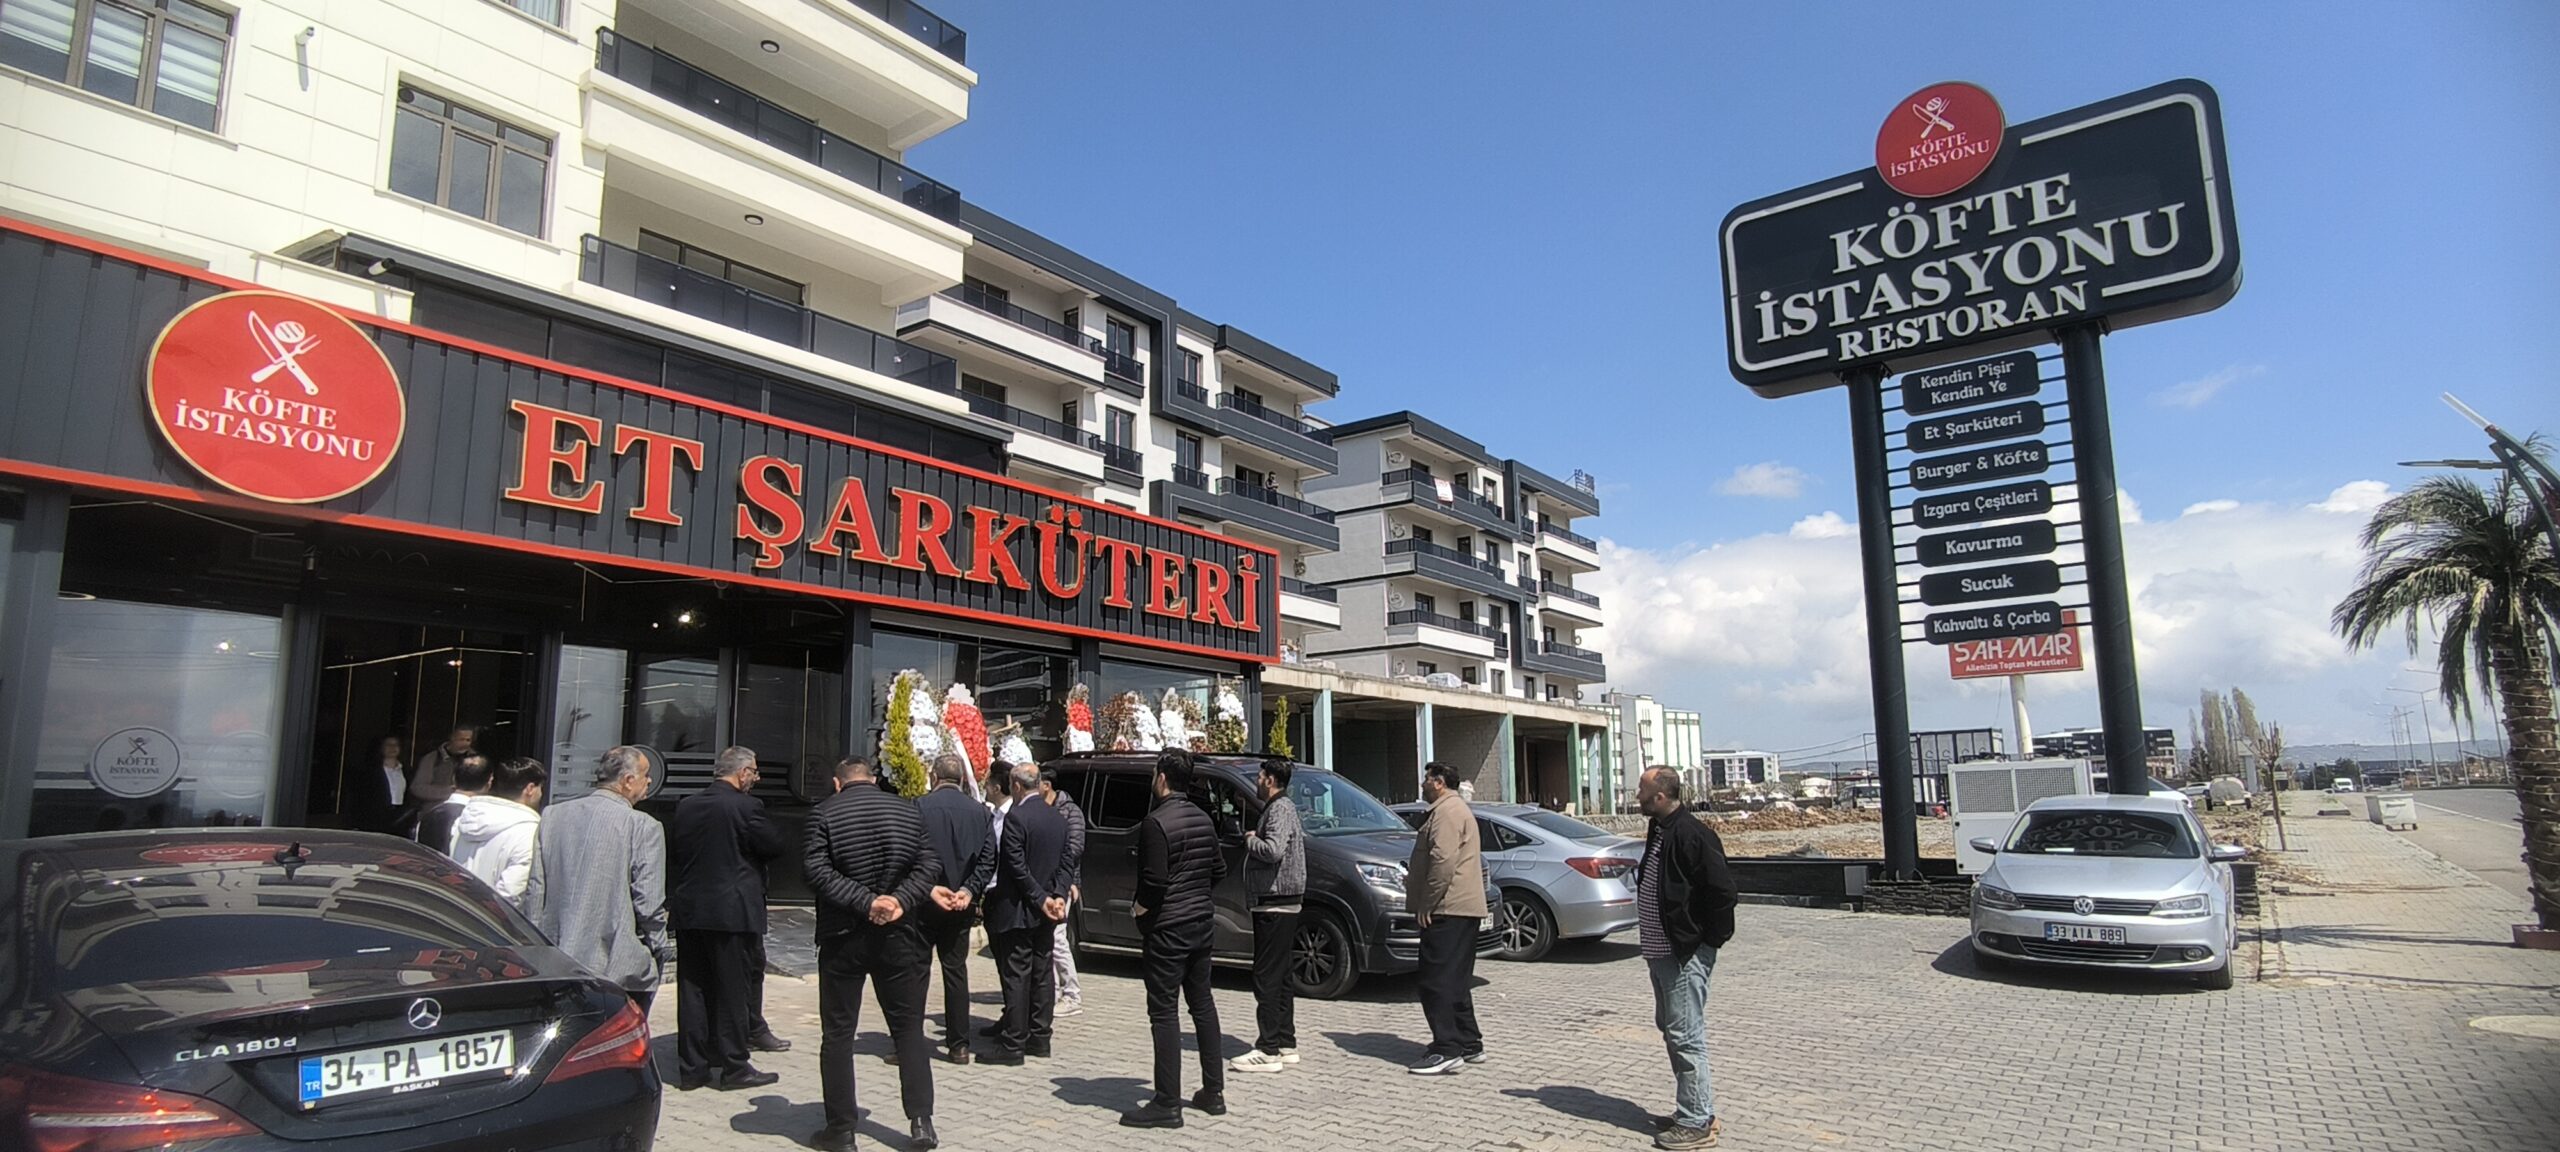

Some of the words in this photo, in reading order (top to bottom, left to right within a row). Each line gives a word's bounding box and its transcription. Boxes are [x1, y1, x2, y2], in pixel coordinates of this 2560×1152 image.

[1890, 140, 1990, 177] İSTASYONU
[1910, 132, 1968, 158] KÖFTE
[1829, 172, 2078, 274] KÖFTE
[1755, 202, 2185, 343] İSTASYONU
[1837, 280, 2090, 361] RESTORAN
[1920, 369, 1973, 389] Kendin
[1978, 361, 2015, 378] Pişir
[1931, 386, 1984, 404] Kendin
[1988, 381, 2007, 394] Ye
[222, 387, 337, 430] KÖFTE
[173, 398, 375, 461] İSTASYONU
[1924, 426, 1941, 440] Et
[1946, 411, 2023, 439] Şarküteri
[1916, 460, 1971, 479] Burger
[1976, 456, 1988, 470] &
[1994, 450, 2039, 467] Köfte
[1975, 488, 2039, 514] Çeşitleri
[503, 399, 706, 528] ET
[736, 453, 1264, 634] ŞARKÜTERİ
[1945, 535, 2023, 555] Kavurma
[1961, 574, 2014, 592] Sucuk
[1934, 616, 1988, 634] Kahvaltı
[1993, 613, 2005, 627] &
[2007, 610, 2051, 630] Çorba
[1999, 661, 2026, 670] Toptan
[2052, 925, 2067, 938] 33
[2072, 927, 2093, 939] AIA
[2100, 929, 2122, 941] 889
[175, 1044, 230, 1062] CLA
[324, 1056, 364, 1091] 34
[384, 1047, 421, 1082] PA
[439, 1034, 506, 1073] 1857
[305, 1080, 321, 1092] TR
